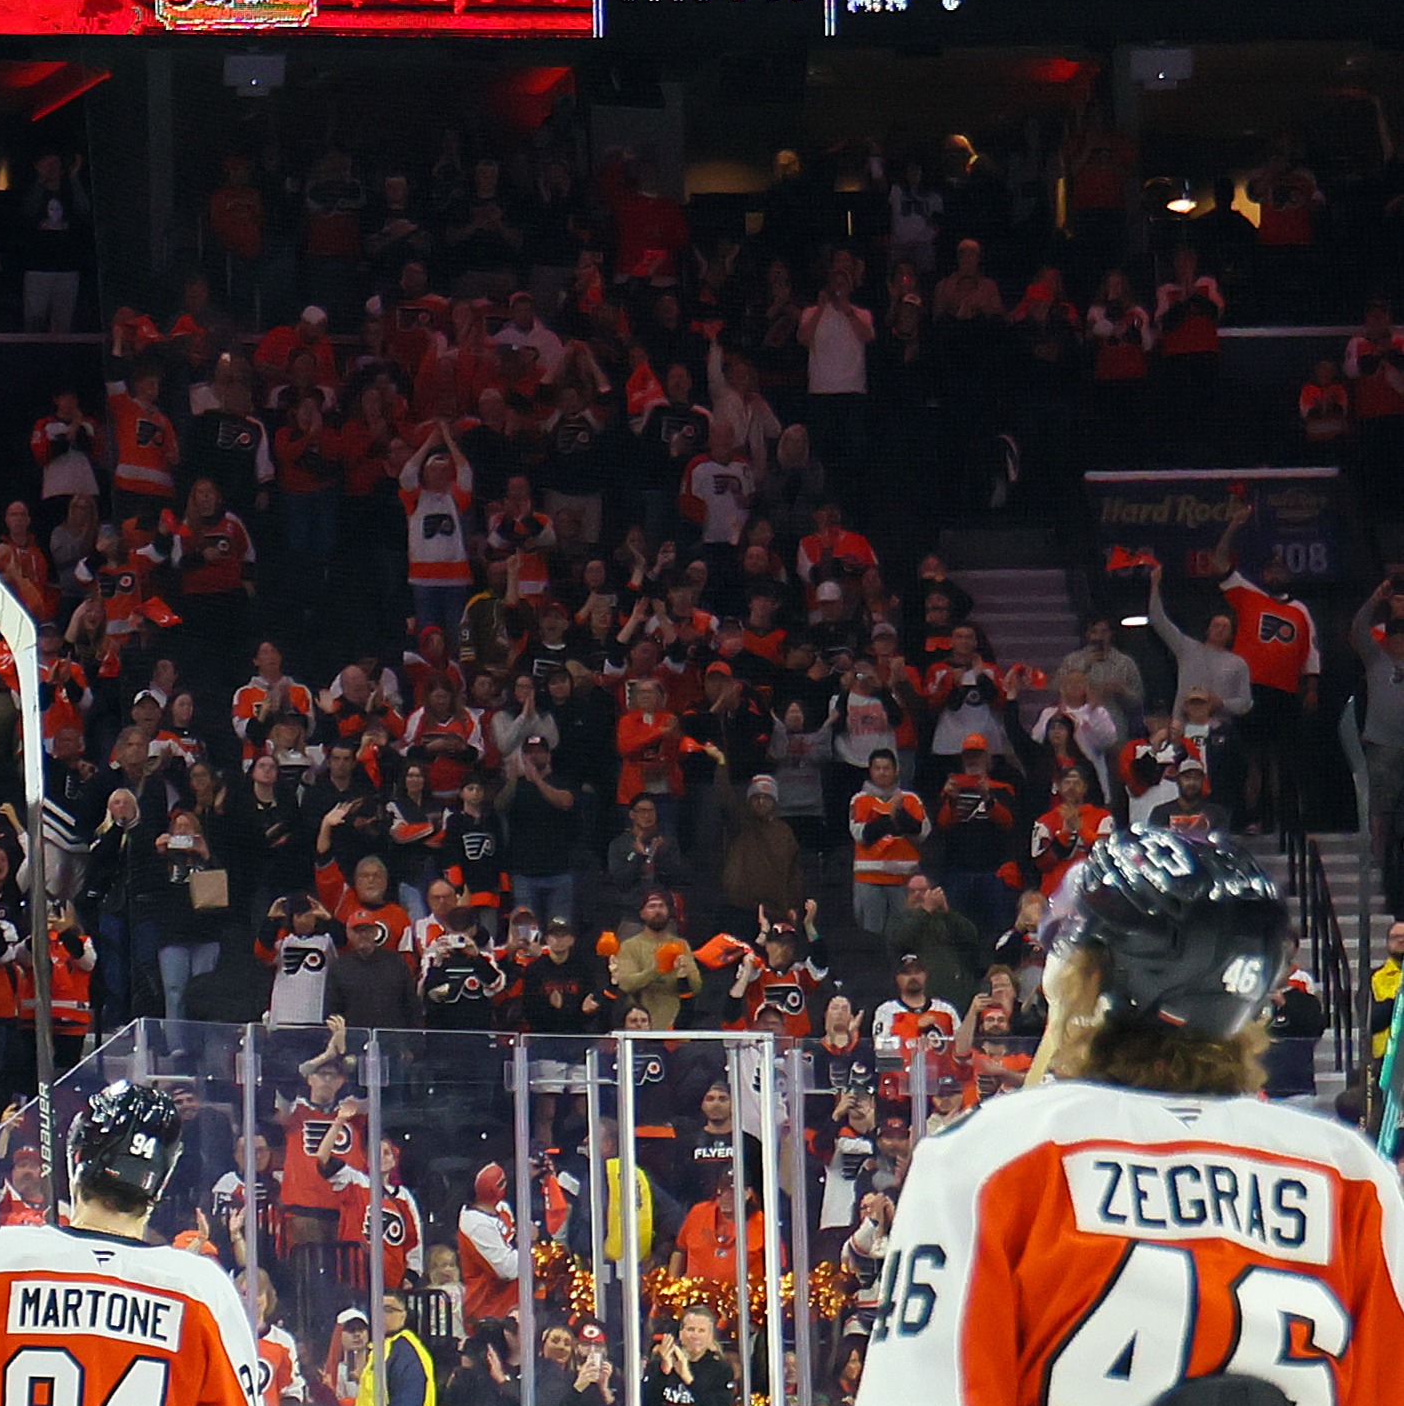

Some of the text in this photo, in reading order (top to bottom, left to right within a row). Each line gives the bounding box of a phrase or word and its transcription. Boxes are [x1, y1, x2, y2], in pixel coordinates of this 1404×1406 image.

[1221, 955, 1260, 995] 46
[38, 1081, 52, 1162] BAUER
[130, 1133, 157, 1159] 94
[693, 1146, 733, 1160] FLYER
[1095, 1161, 1309, 1249] ZEGRAS
[19, 1288, 171, 1342] MARTONE
